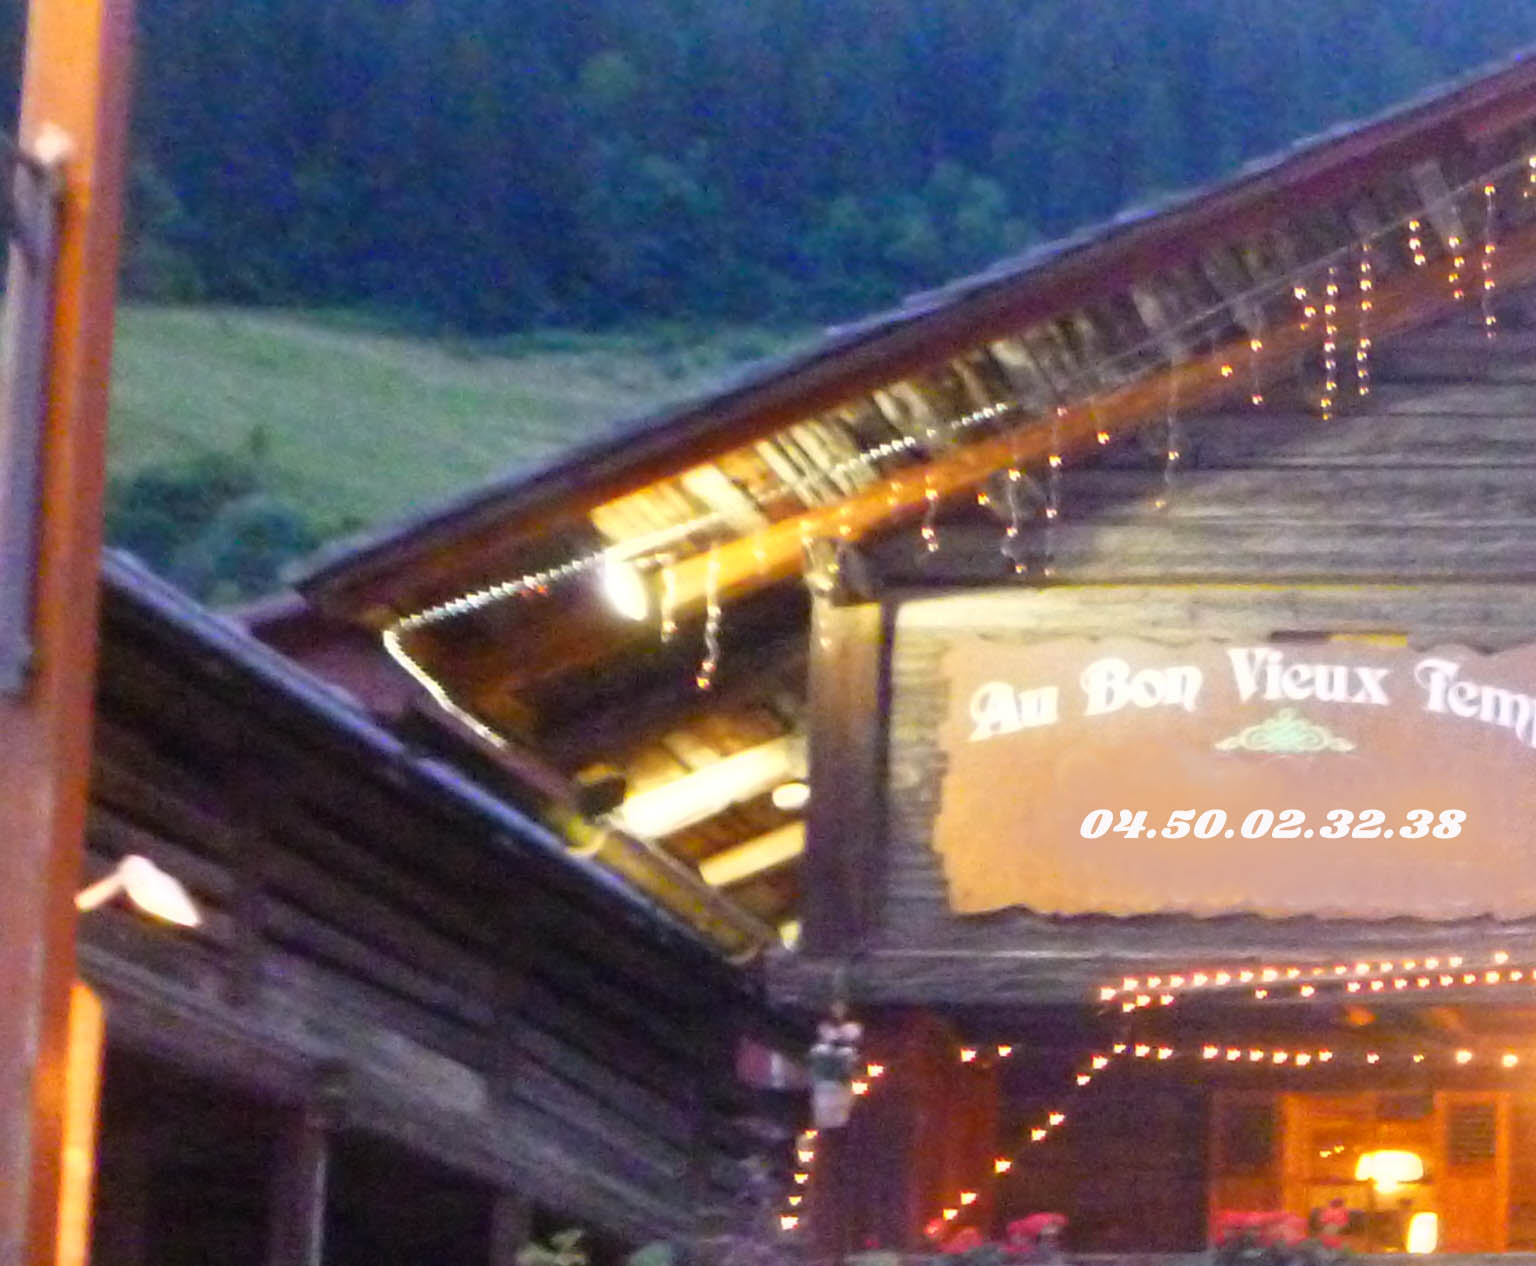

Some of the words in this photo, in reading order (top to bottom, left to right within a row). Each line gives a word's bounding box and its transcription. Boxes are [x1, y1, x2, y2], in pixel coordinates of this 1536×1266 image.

[968, 681, 1059, 742] Au
[1080, 657, 1203, 715] Bon
[1227, 647, 1389, 706] Vieux
